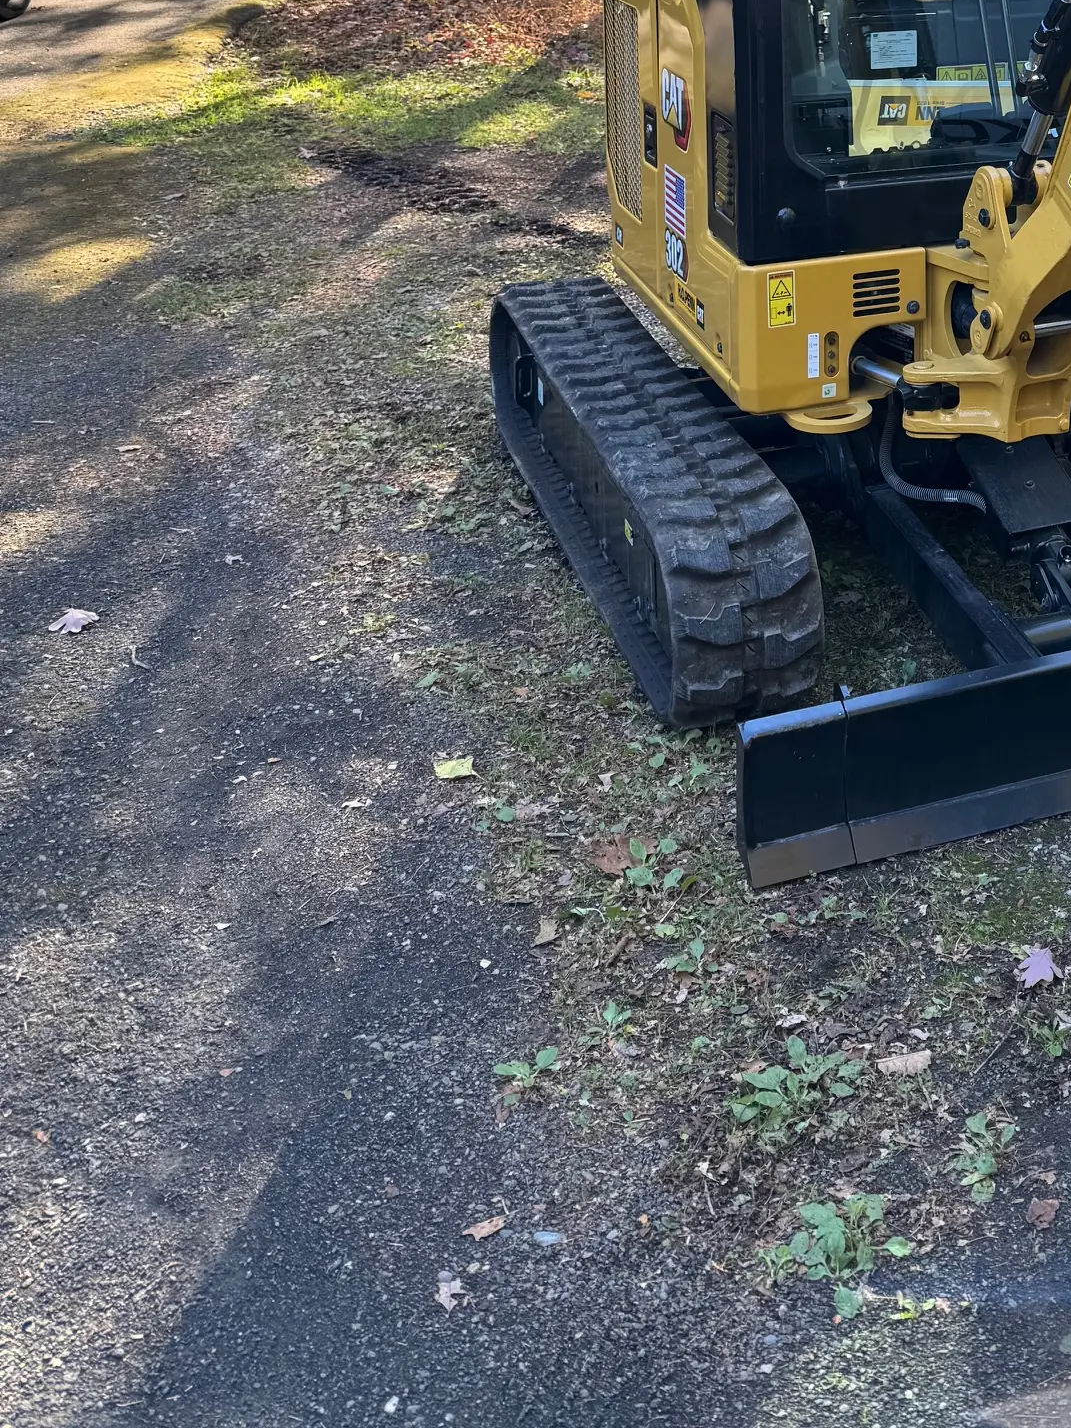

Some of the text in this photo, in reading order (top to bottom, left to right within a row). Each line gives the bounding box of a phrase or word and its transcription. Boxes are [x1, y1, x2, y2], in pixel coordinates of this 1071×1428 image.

[661, 68, 685, 131] CAT
[879, 103, 907, 119] CAT
[665, 229, 685, 279] 302
